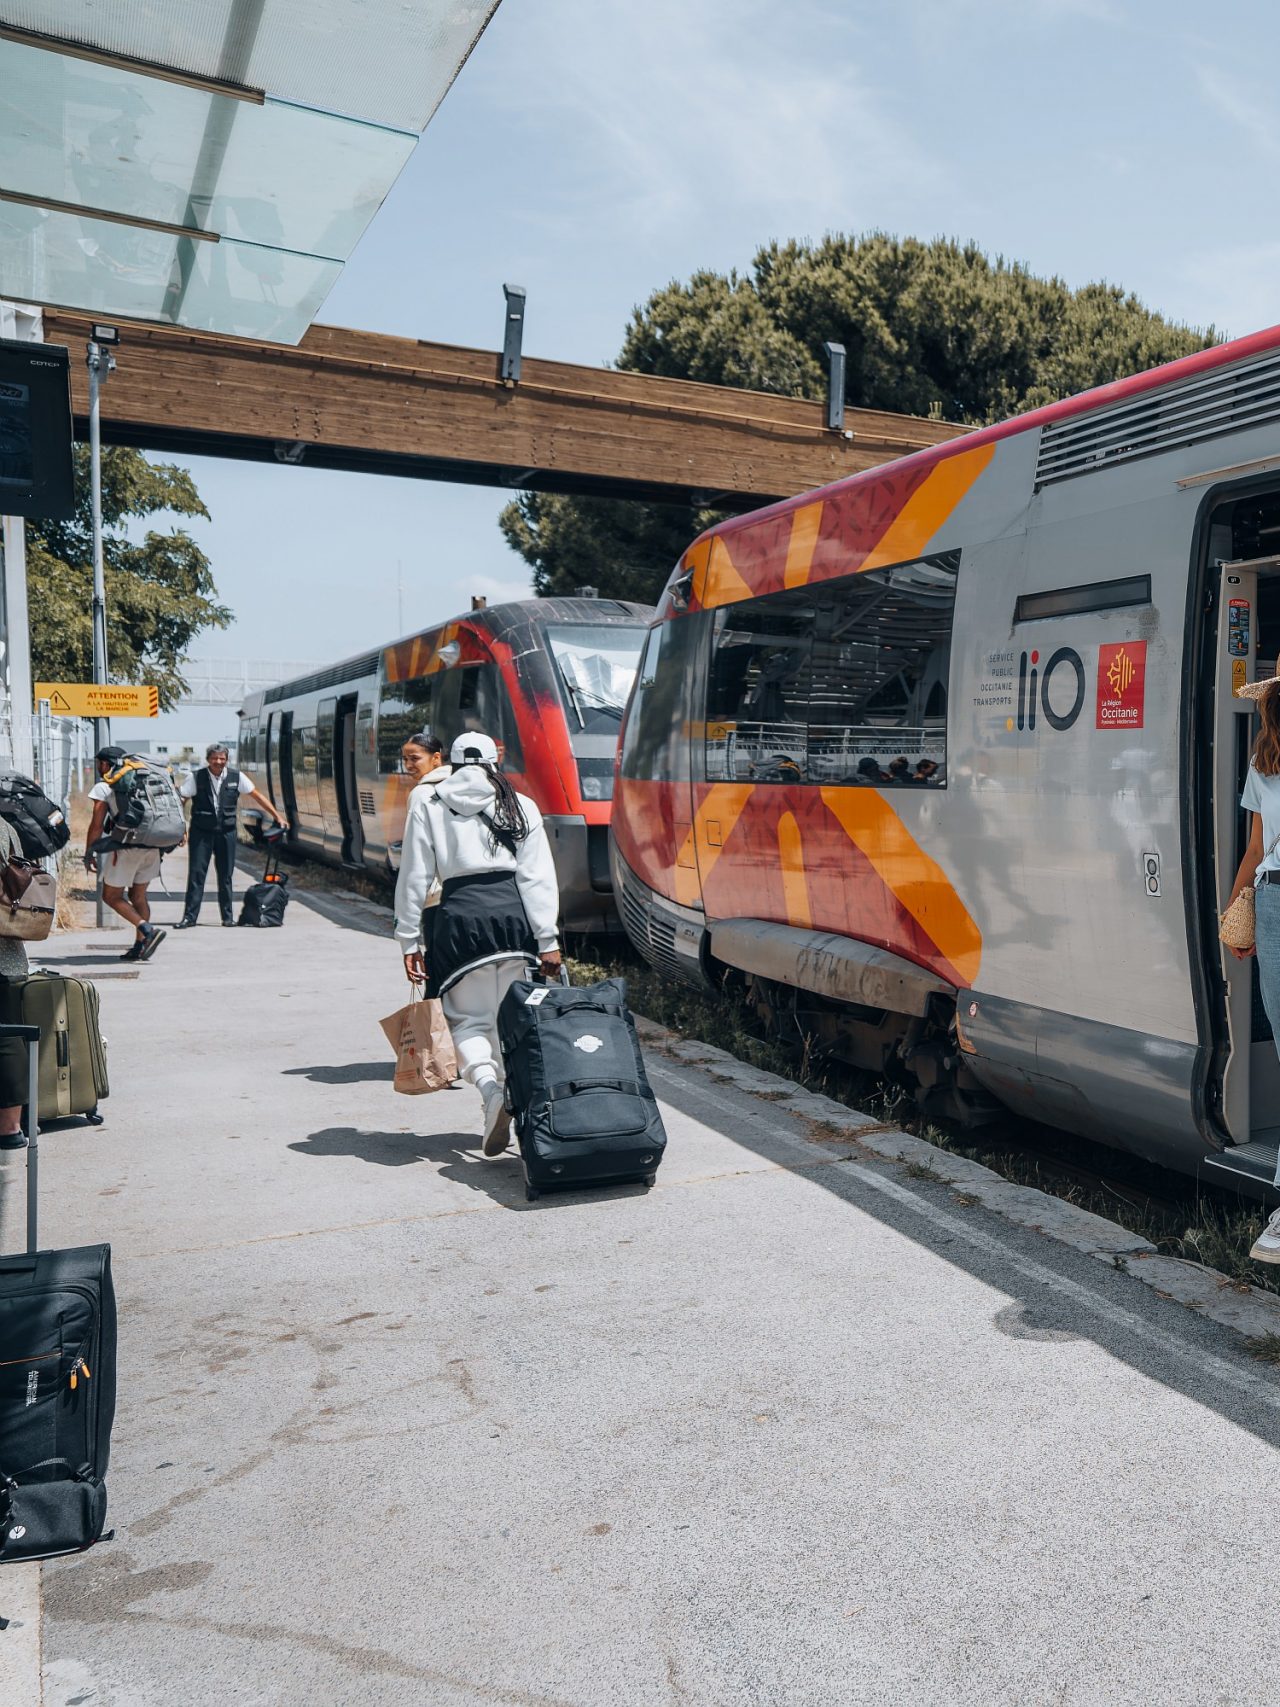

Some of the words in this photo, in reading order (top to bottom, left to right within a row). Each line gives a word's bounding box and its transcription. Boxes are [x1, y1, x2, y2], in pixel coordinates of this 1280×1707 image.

[989, 653, 1014, 662] SERVICE
[992, 668, 1014, 677] PUBLIC
[980, 682, 1013, 692] OCCITANIE
[87, 692, 138, 700] ATTENTION
[973, 696, 1012, 706] TRANSPORTS
[1107, 699, 1122, 707] Région
[1101, 706, 1138, 718] Occitanie
[25, 1370, 33, 1407] TOURISTER
[31, 1370, 39, 1403] AMERICAN
